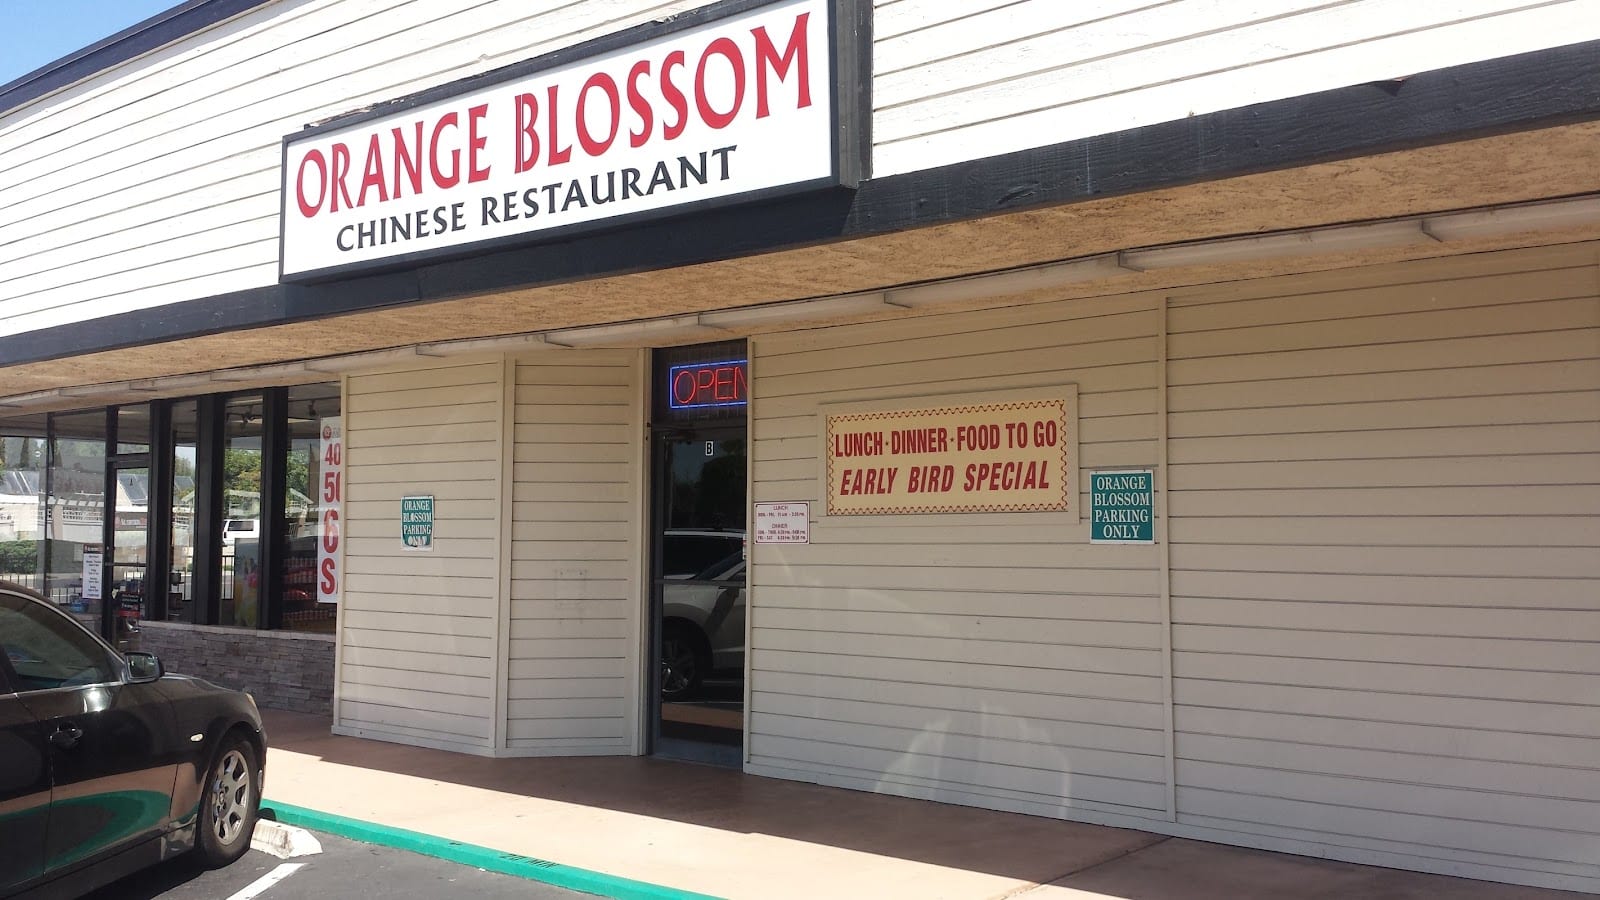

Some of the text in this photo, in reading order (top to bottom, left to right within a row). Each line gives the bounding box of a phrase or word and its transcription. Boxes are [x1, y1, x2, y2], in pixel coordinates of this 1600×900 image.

[296, 11, 812, 218] ORANGE BLOSSOM
[336, 144, 738, 252] CHINESE RESTAURANT
[835, 420, 1057, 458] LUNCH DINNER FOOD TO GO
[706, 442, 713, 455] B
[840, 460, 1050, 496] EARLY BIRD SPECIAL
[1096, 476, 1147, 491] ORANGE
[404, 500, 431, 511] ORANGE
[1094, 492, 1151, 506] BLOSSOM
[403, 512, 432, 522] BLOSSOM
[1095, 509, 1149, 523] PARKING
[403, 524, 432, 535] PARKING
[1103, 524, 1141, 538] ONLY
[407, 535, 428, 546] ONLY
